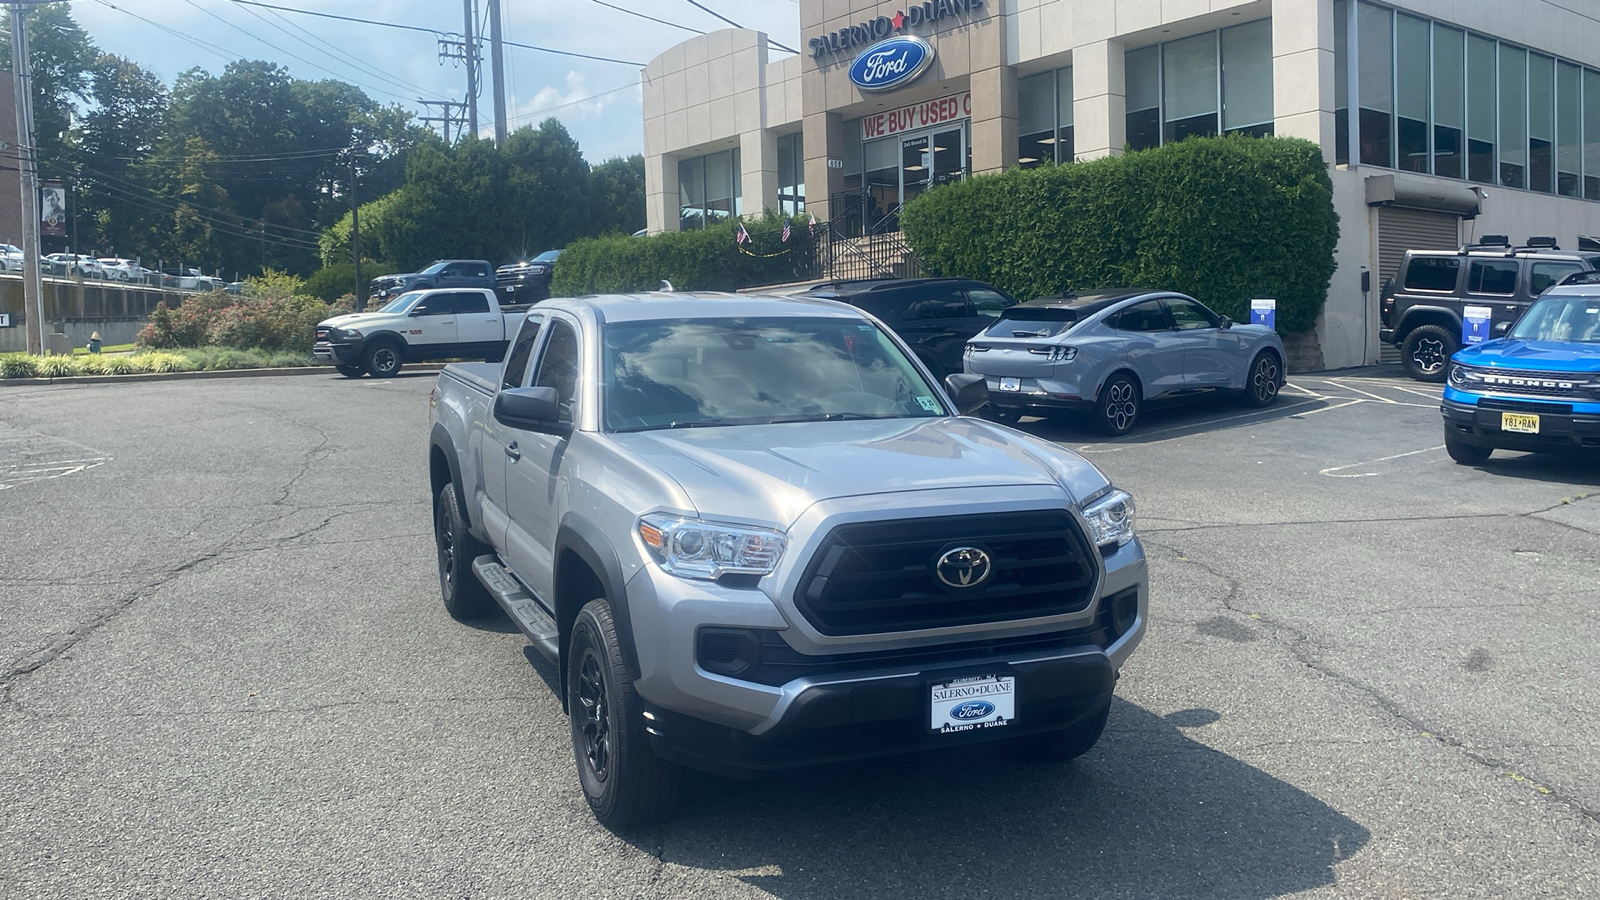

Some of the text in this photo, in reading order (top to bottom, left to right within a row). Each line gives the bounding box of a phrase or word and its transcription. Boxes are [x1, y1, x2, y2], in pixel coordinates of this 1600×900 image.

[808, 15, 893, 59] SALERNO
[863, 48, 909, 83] Ford
[863, 115, 885, 138] WE
[888, 106, 916, 133] BUY
[920, 98, 958, 126] USED
[1483, 377, 1573, 389] BRONCO
[933, 682, 1013, 701] SALERNO DUANE
[958, 703, 986, 718] Ford
[940, 719, 1008, 733] SALERNO DUANE
